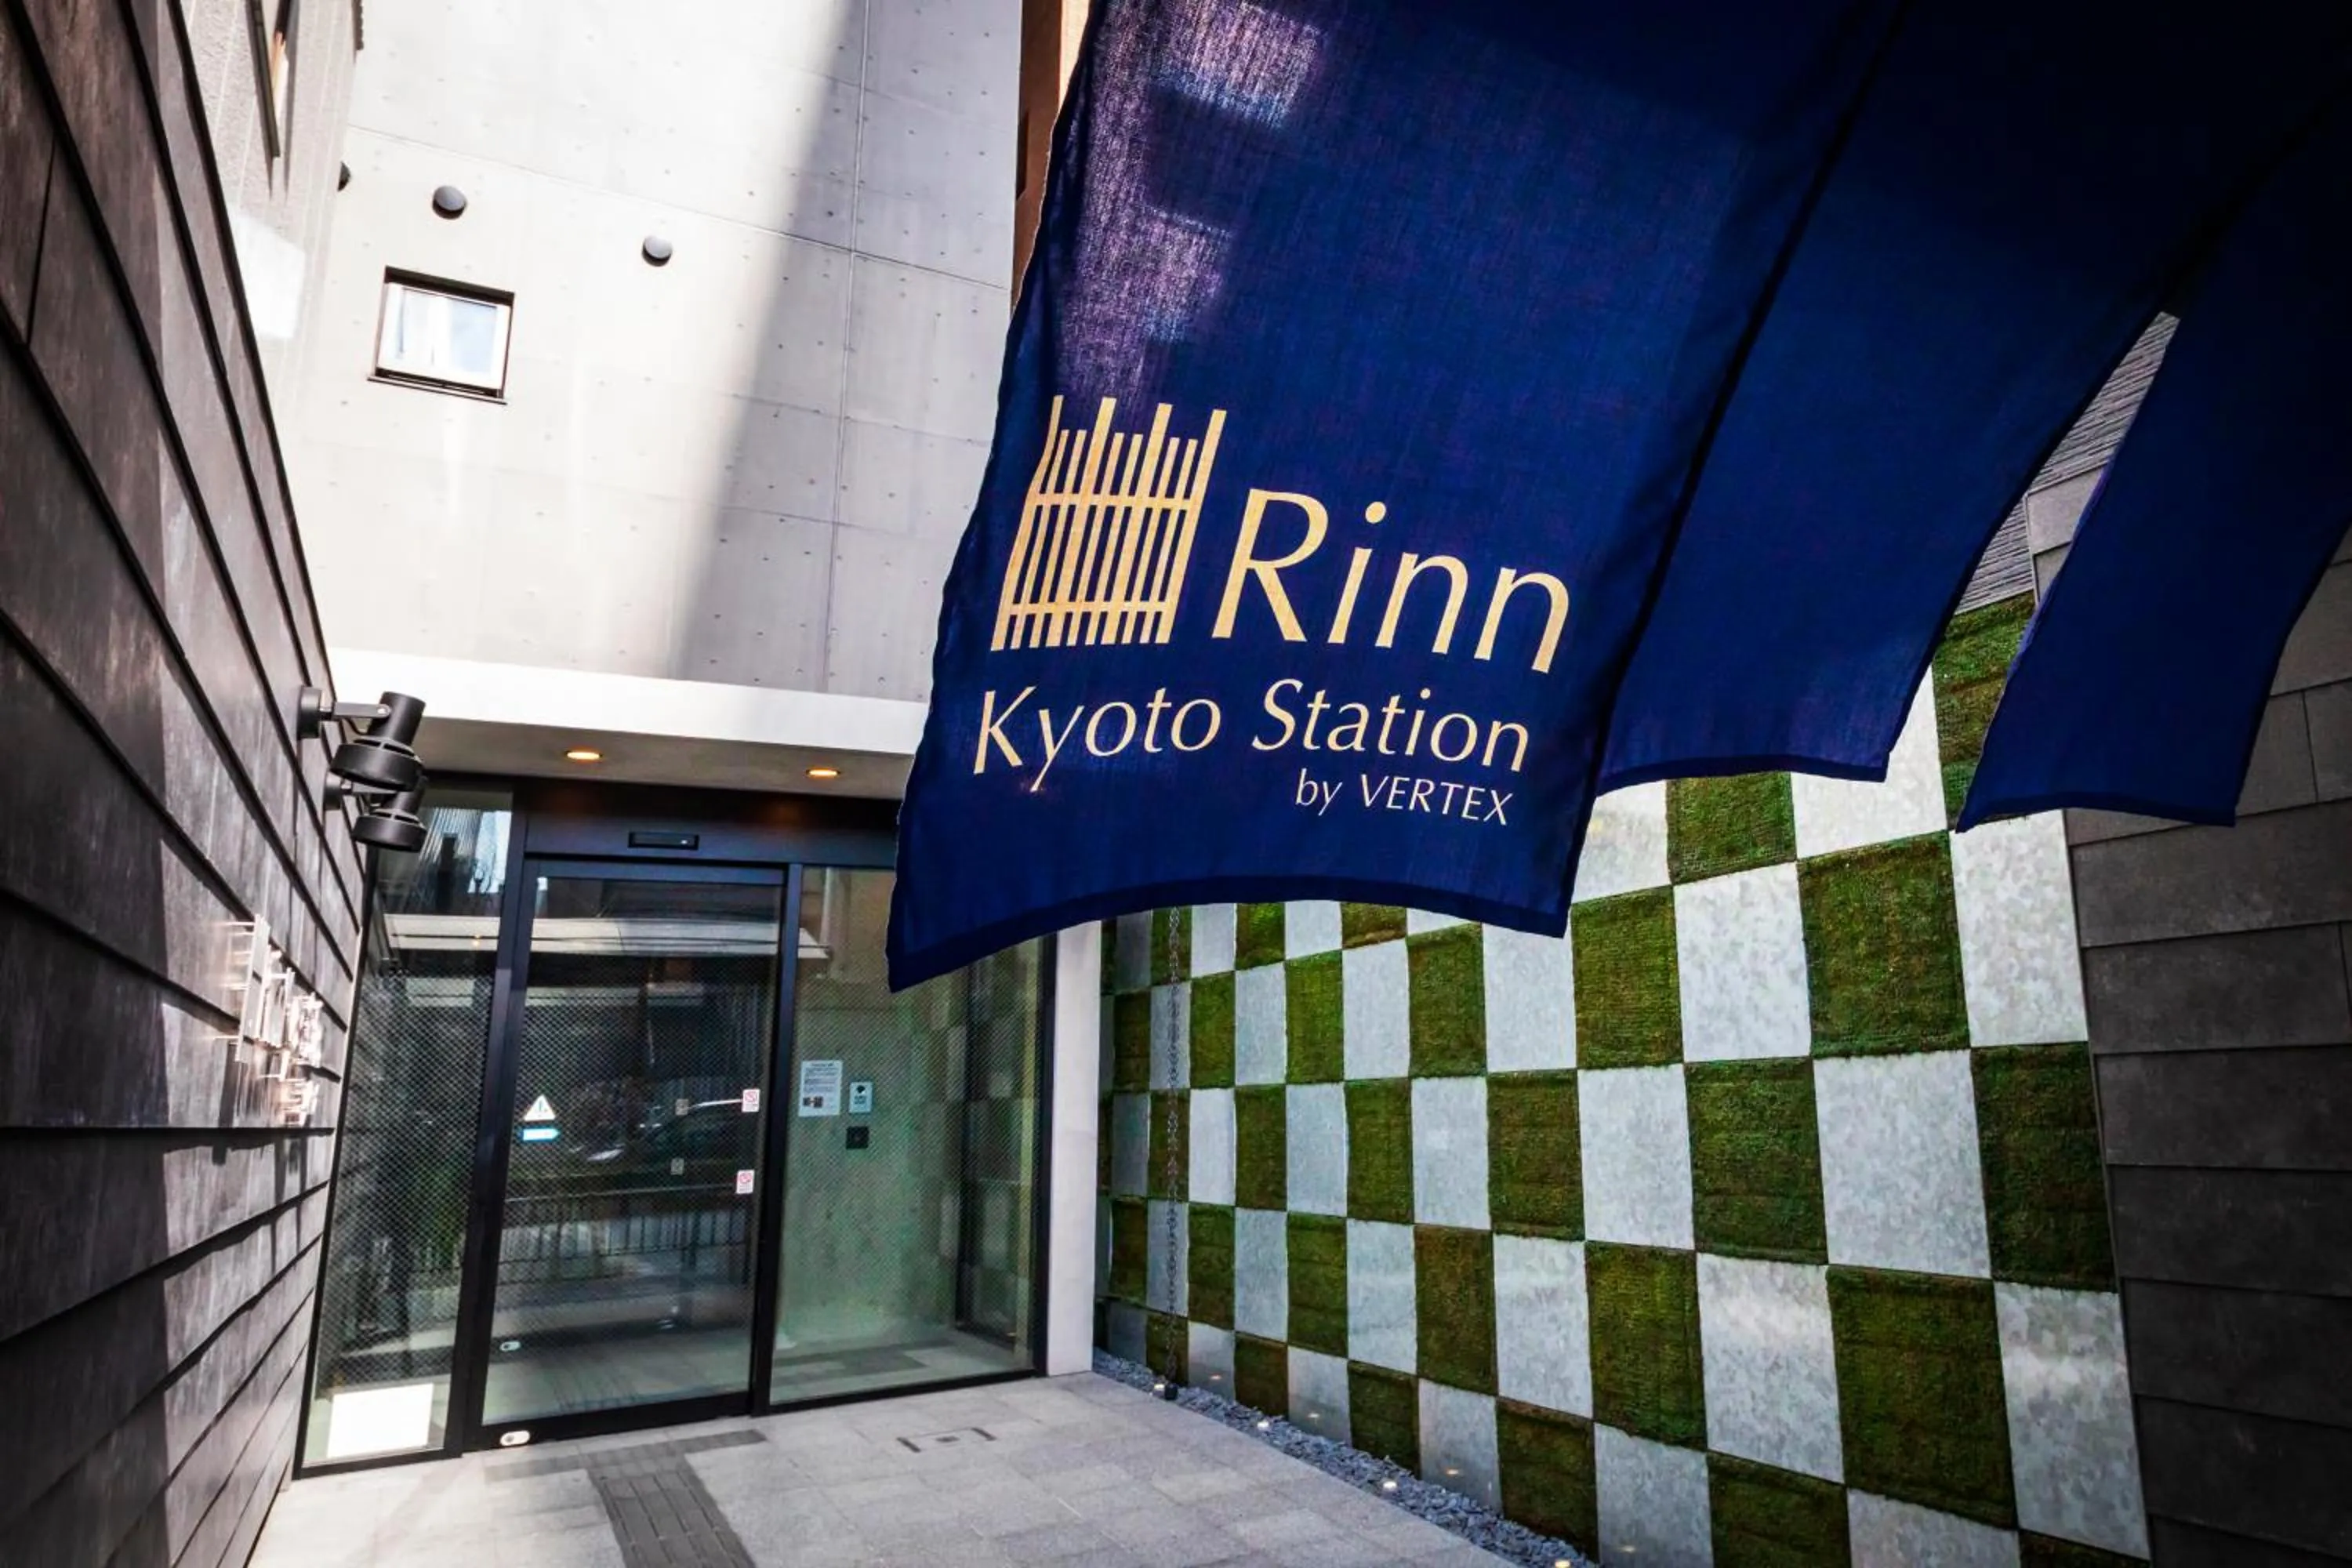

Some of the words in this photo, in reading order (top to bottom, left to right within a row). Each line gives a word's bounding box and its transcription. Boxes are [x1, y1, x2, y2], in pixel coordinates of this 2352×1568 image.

[1212, 489, 1568, 673] Rinn
[975, 687, 1221, 792] Kyoto
[1252, 679, 1528, 771] Station
[1296, 768, 1343, 816] by
[1361, 775, 1512, 825] VERTEX
